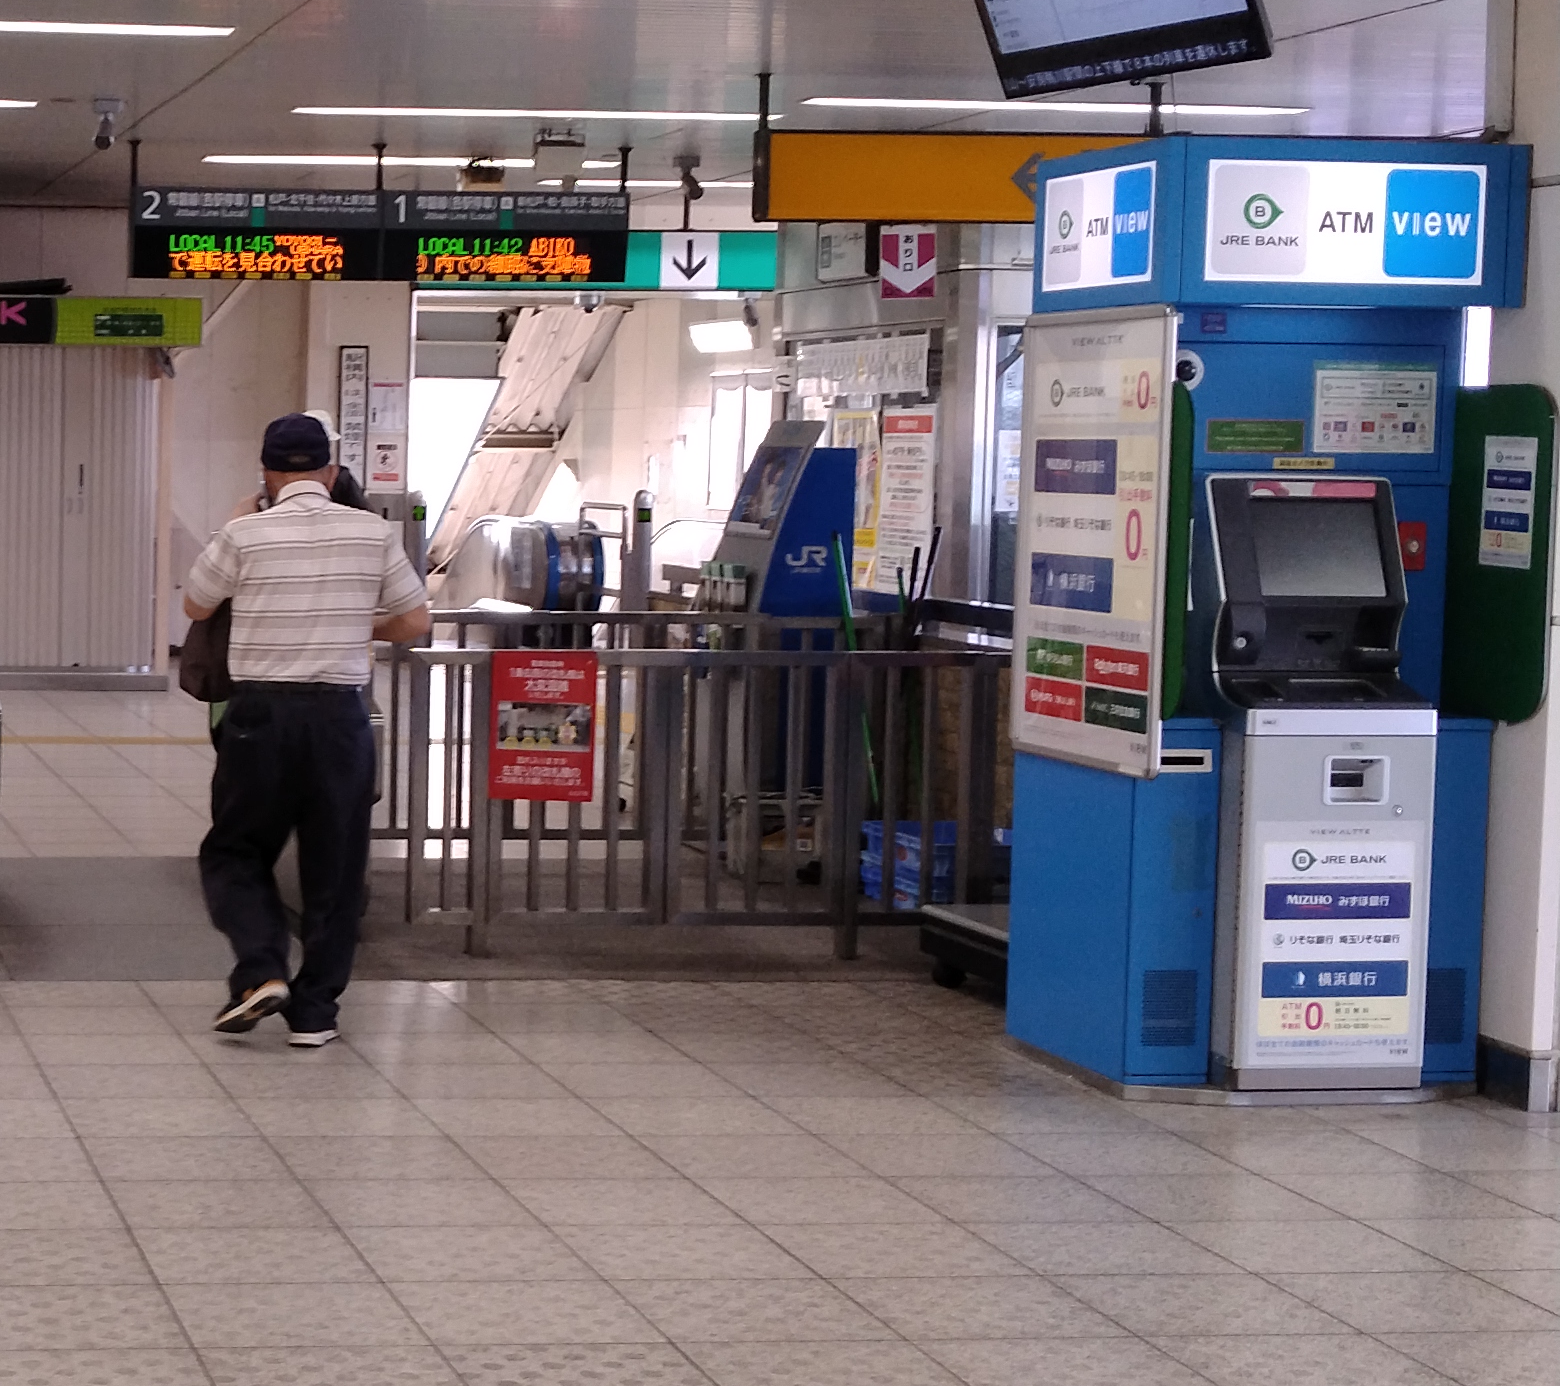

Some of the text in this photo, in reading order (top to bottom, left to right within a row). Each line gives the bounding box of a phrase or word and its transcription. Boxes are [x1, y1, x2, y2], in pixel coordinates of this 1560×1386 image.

[141, 191, 162, 219] 2
[394, 195, 407, 223] 1
[1086, 217, 1109, 237] ATM
[1319, 211, 1373, 234] ATM
[169, 235, 221, 252] LOCAL
[224, 235, 274, 253] 11:45
[418, 237, 576, 256] LOCAL 11:42 ABIKO
[1220, 235, 1299, 247] JRE BANK
[785, 546, 828, 566] JR
[1321, 855, 1387, 864] JRE BANK
[1286, 894, 1390, 907] MIZUHO みずほ銀行
[1290, 935, 1334, 945] りそな銀行
[1318, 971, 1378, 987] 横浜銀行
